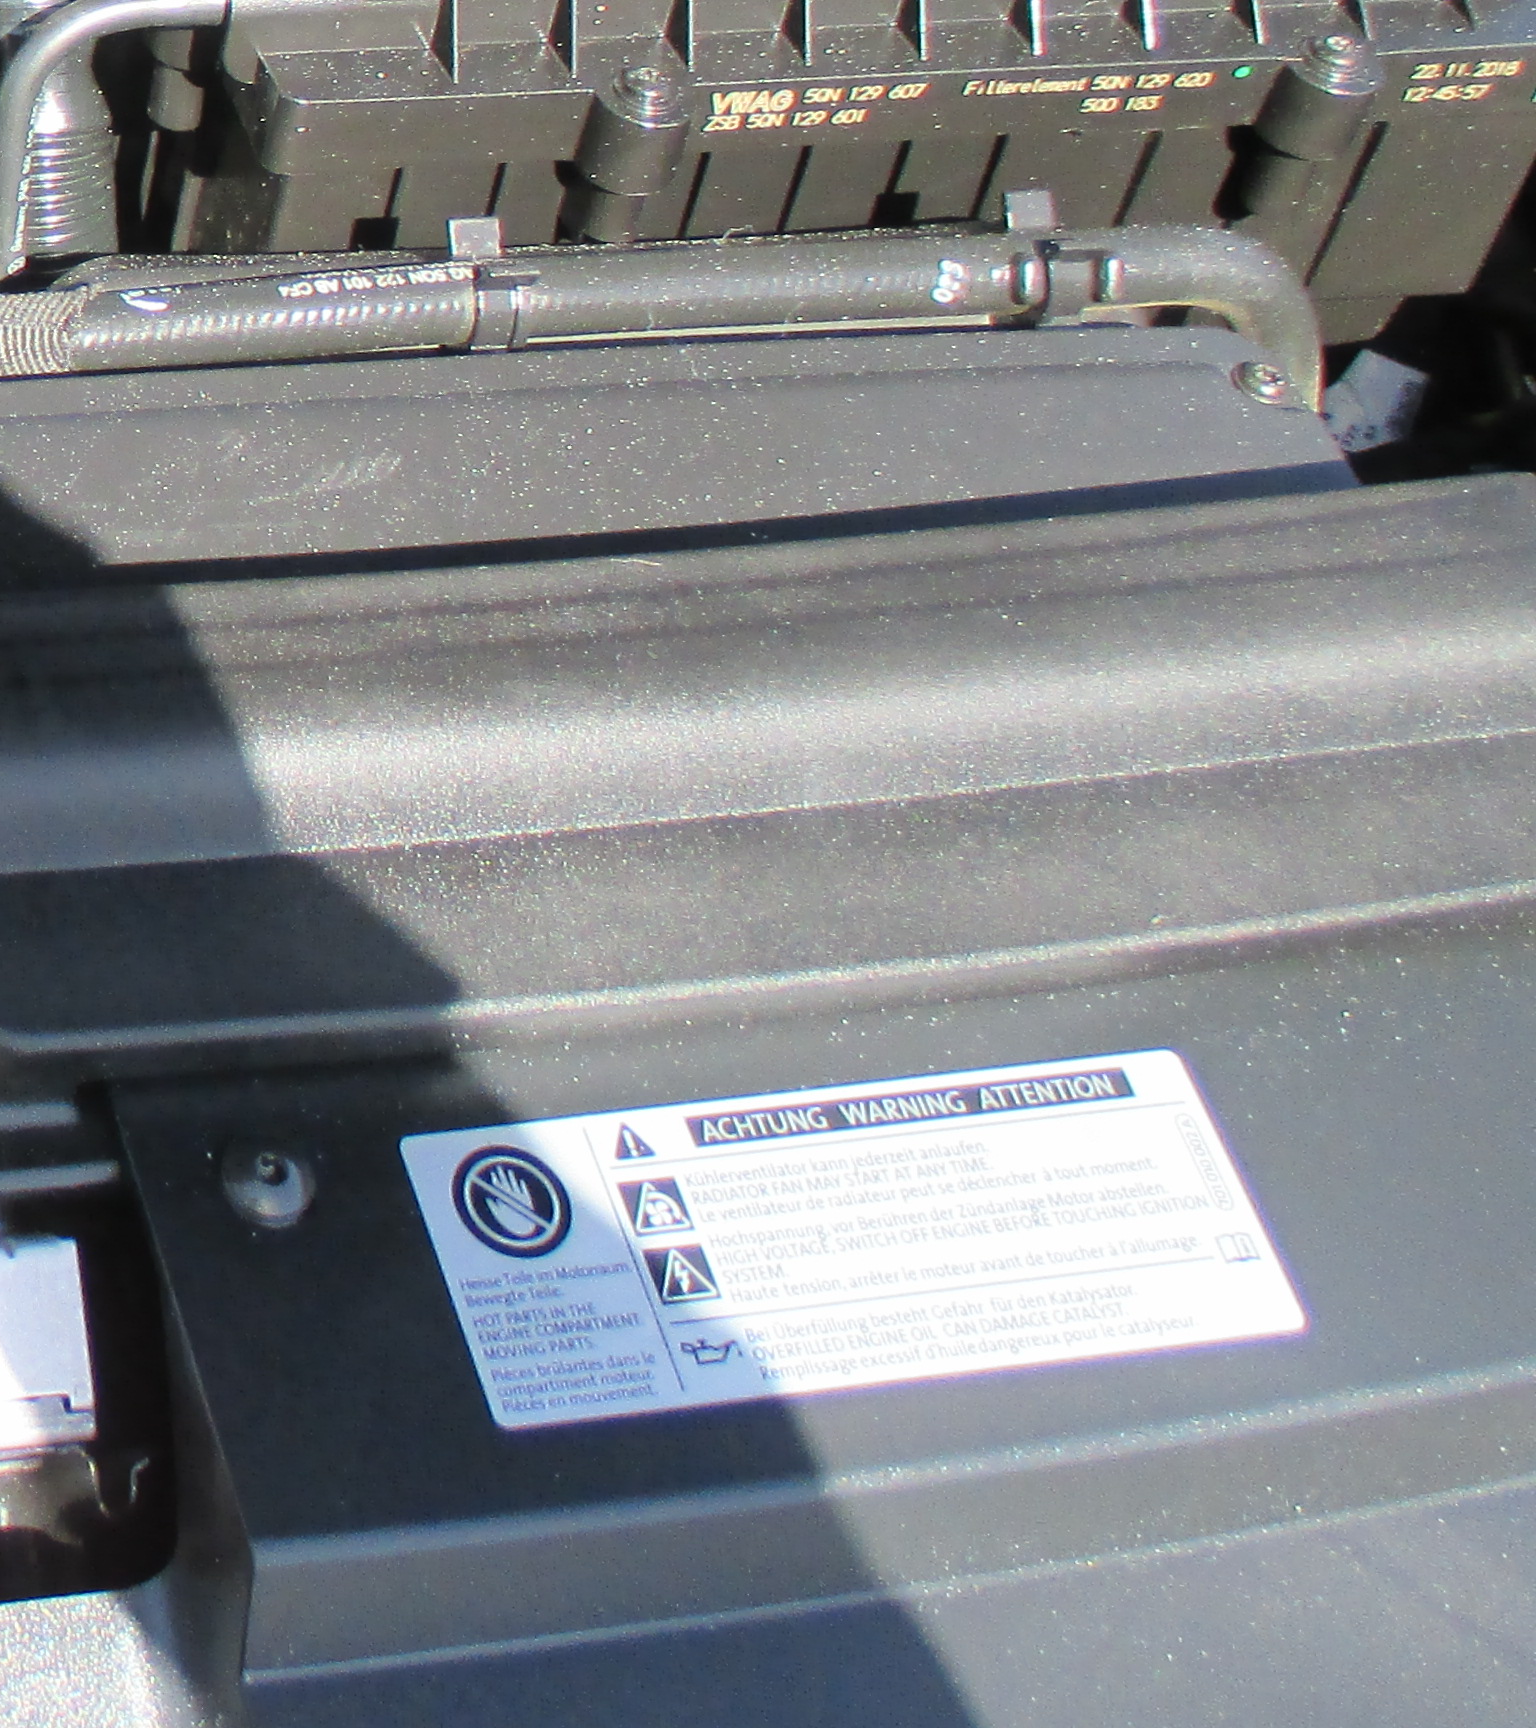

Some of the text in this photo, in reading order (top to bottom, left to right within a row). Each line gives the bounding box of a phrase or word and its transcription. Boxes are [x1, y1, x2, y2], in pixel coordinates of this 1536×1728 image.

[847, 85, 887, 101] 129
[887, 82, 931, 100] 607
[961, 76, 1092, 96] Filterelement
[1134, 72, 1174, 89] 129
[1174, 71, 1217, 88] 620
[702, 114, 743, 132] ZSB
[791, 110, 830, 126] 129
[830, 108, 871, 125] 601
[1079, 95, 1166, 114] 500 183
[277, 282, 313, 298] CF4
[312, 278, 341, 294] AB
[342, 275, 374, 291] 101
[373, 273, 407, 289] 122
[700, 1073, 1116, 1143] ACHTUNG WARNING ATTENTION
[684, 1140, 989, 1187] Kühlerventilator kann jederzeit anlaufen.
[690, 1157, 994, 1205] RADIATOR FAN MAY START AT ANY TIME.
[699, 1156, 1159, 1223] Le ventilateur de radiateur peut se déclencher tout moment.
[709, 1182, 1170, 1250] Hochspannung, vor Berühren der Zündanlage Motor abstellen.
[716, 1193, 1209, 1268] HIGH VOLTAGE, SWITCH OFF ENGINE BEFORE TOUCHING IGNITION
[721, 1264, 790, 1284] SYSTEM.
[730, 1234, 1204, 1304] Haute tension, arrêter le moteur avant de toucher l'allumage.
[472, 1315, 501, 1328] HOT
[550, 1305, 568, 1318] IN
[569, 1302, 596, 1315] THE
[476, 1311, 640, 1343] ENGINE COMPARTMENT
[745, 1284, 1138, 1344] Bei Überfüllung besteht Gefahr für den Katalysator.
[752, 1338, 846, 1361] OVERFILLED
[848, 1330, 907, 1349] ENGINE
[910, 1325, 938, 1342] OIL
[942, 1320, 979, 1339] CAN
[980, 1311, 1051, 1333] DAMAGE
[759, 1357, 858, 1381] Remplissage
[861, 1345, 922, 1368] excessif
[979, 1332, 1060, 1355] dangereux
[1063, 1329, 1098, 1347] pour
[1101, 1325, 1116, 1338] le
[1118, 1316, 1200, 1337] catalyseur.
